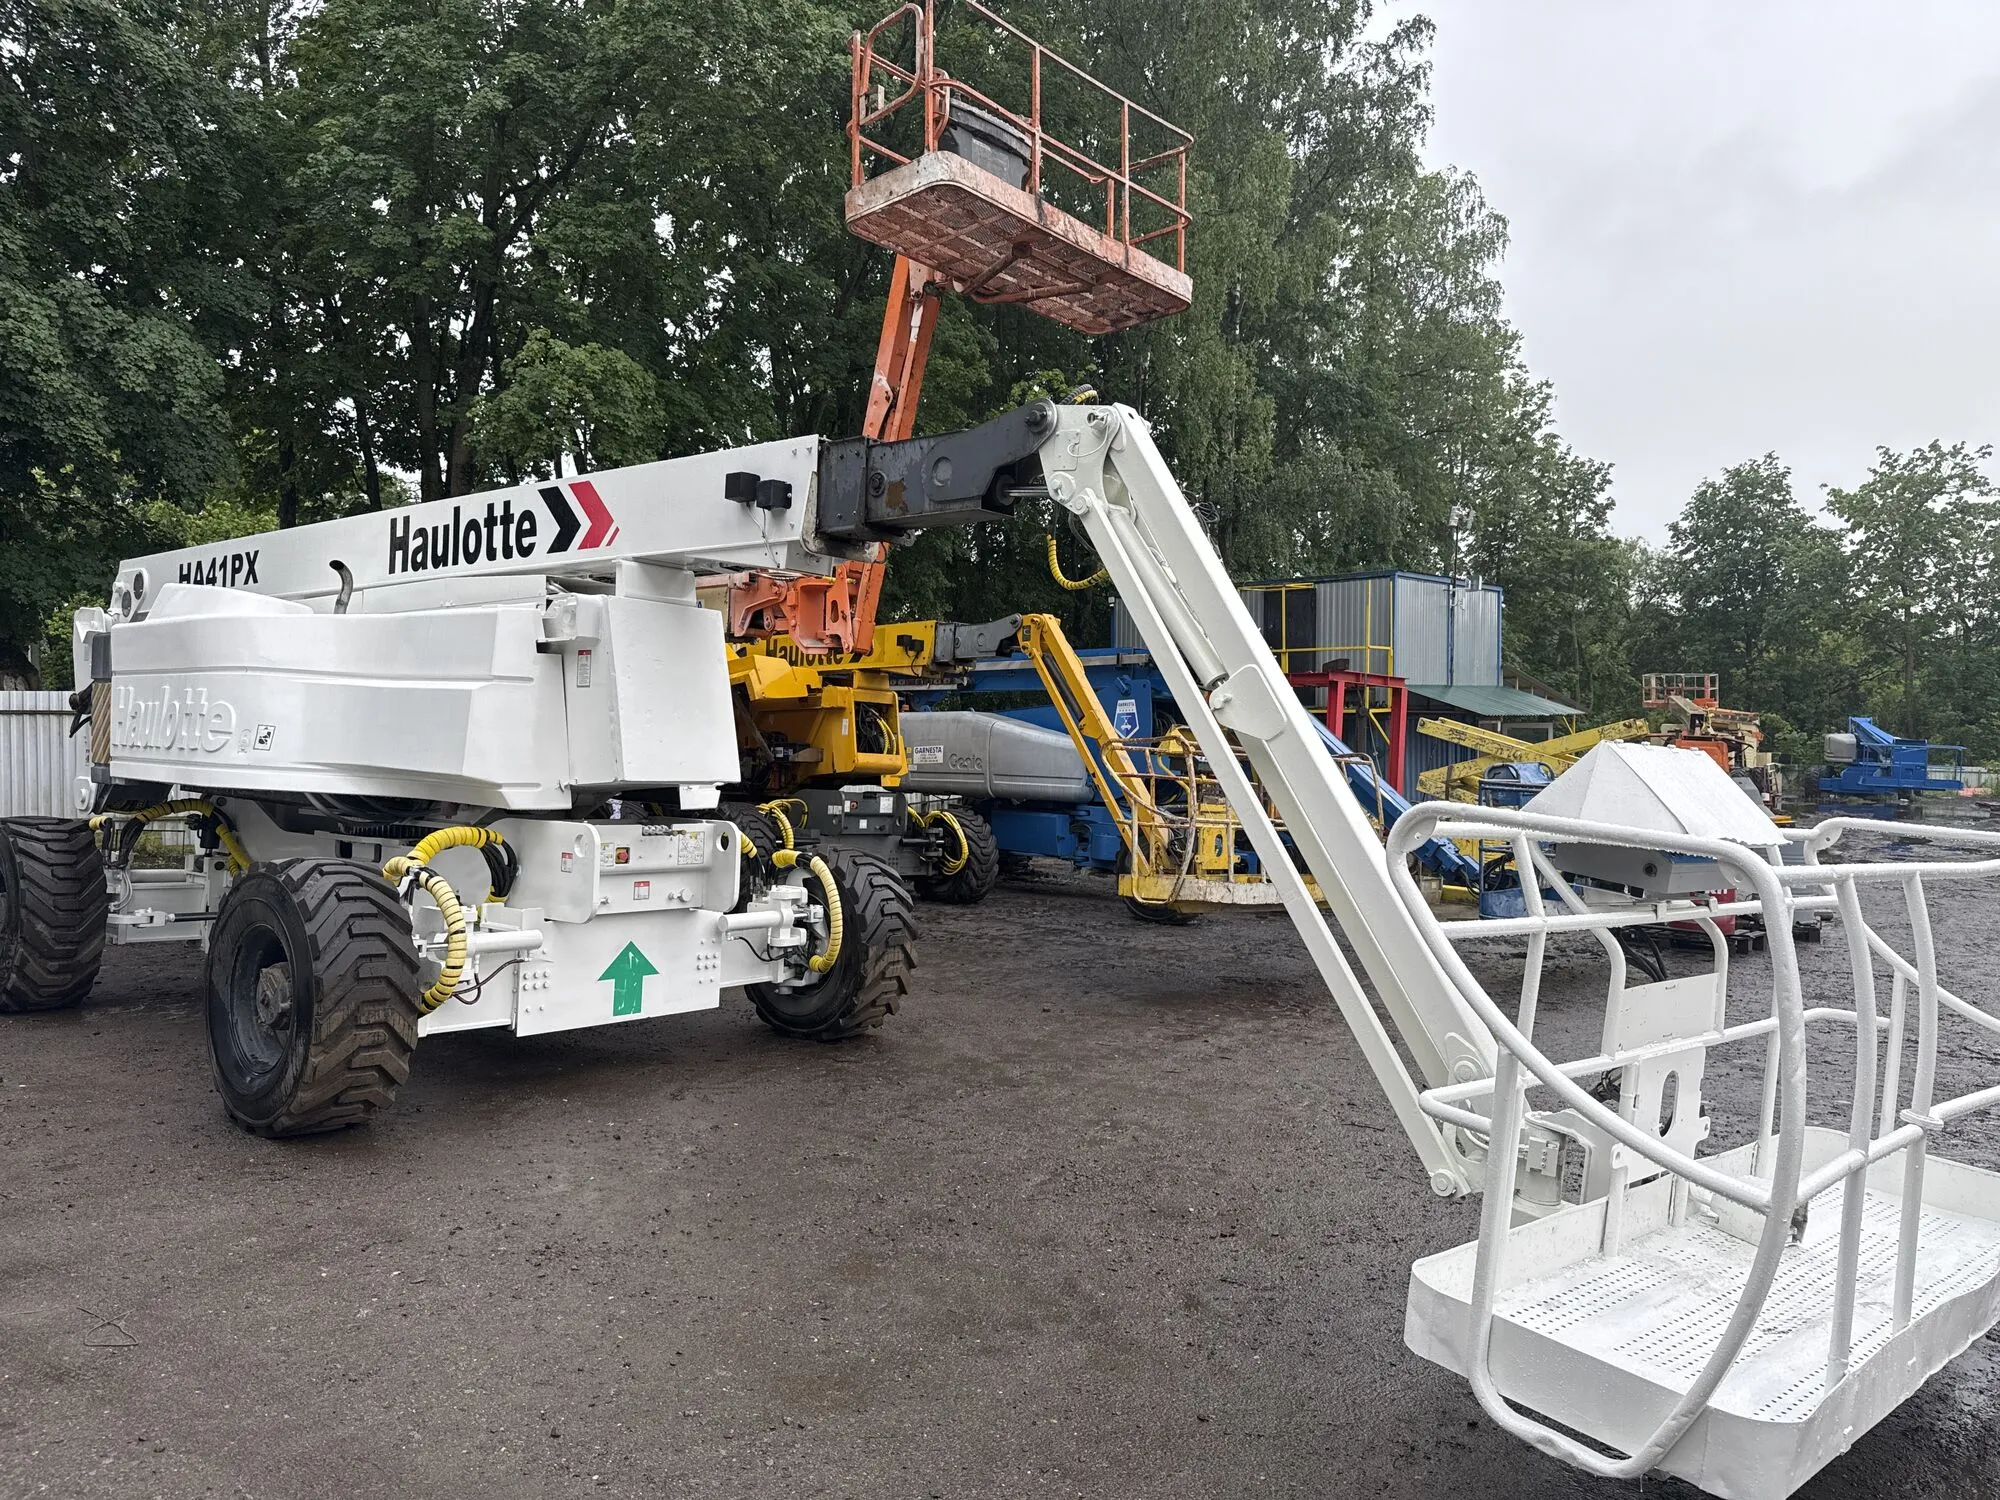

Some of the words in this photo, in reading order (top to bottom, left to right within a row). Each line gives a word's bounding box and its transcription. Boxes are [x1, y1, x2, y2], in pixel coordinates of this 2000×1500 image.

[388, 500, 537, 575] Haulotte
[179, 550, 260, 587] HA41PX
[111, 684, 237, 753] Haulotte
[914, 746, 943, 754] GARNESTA
